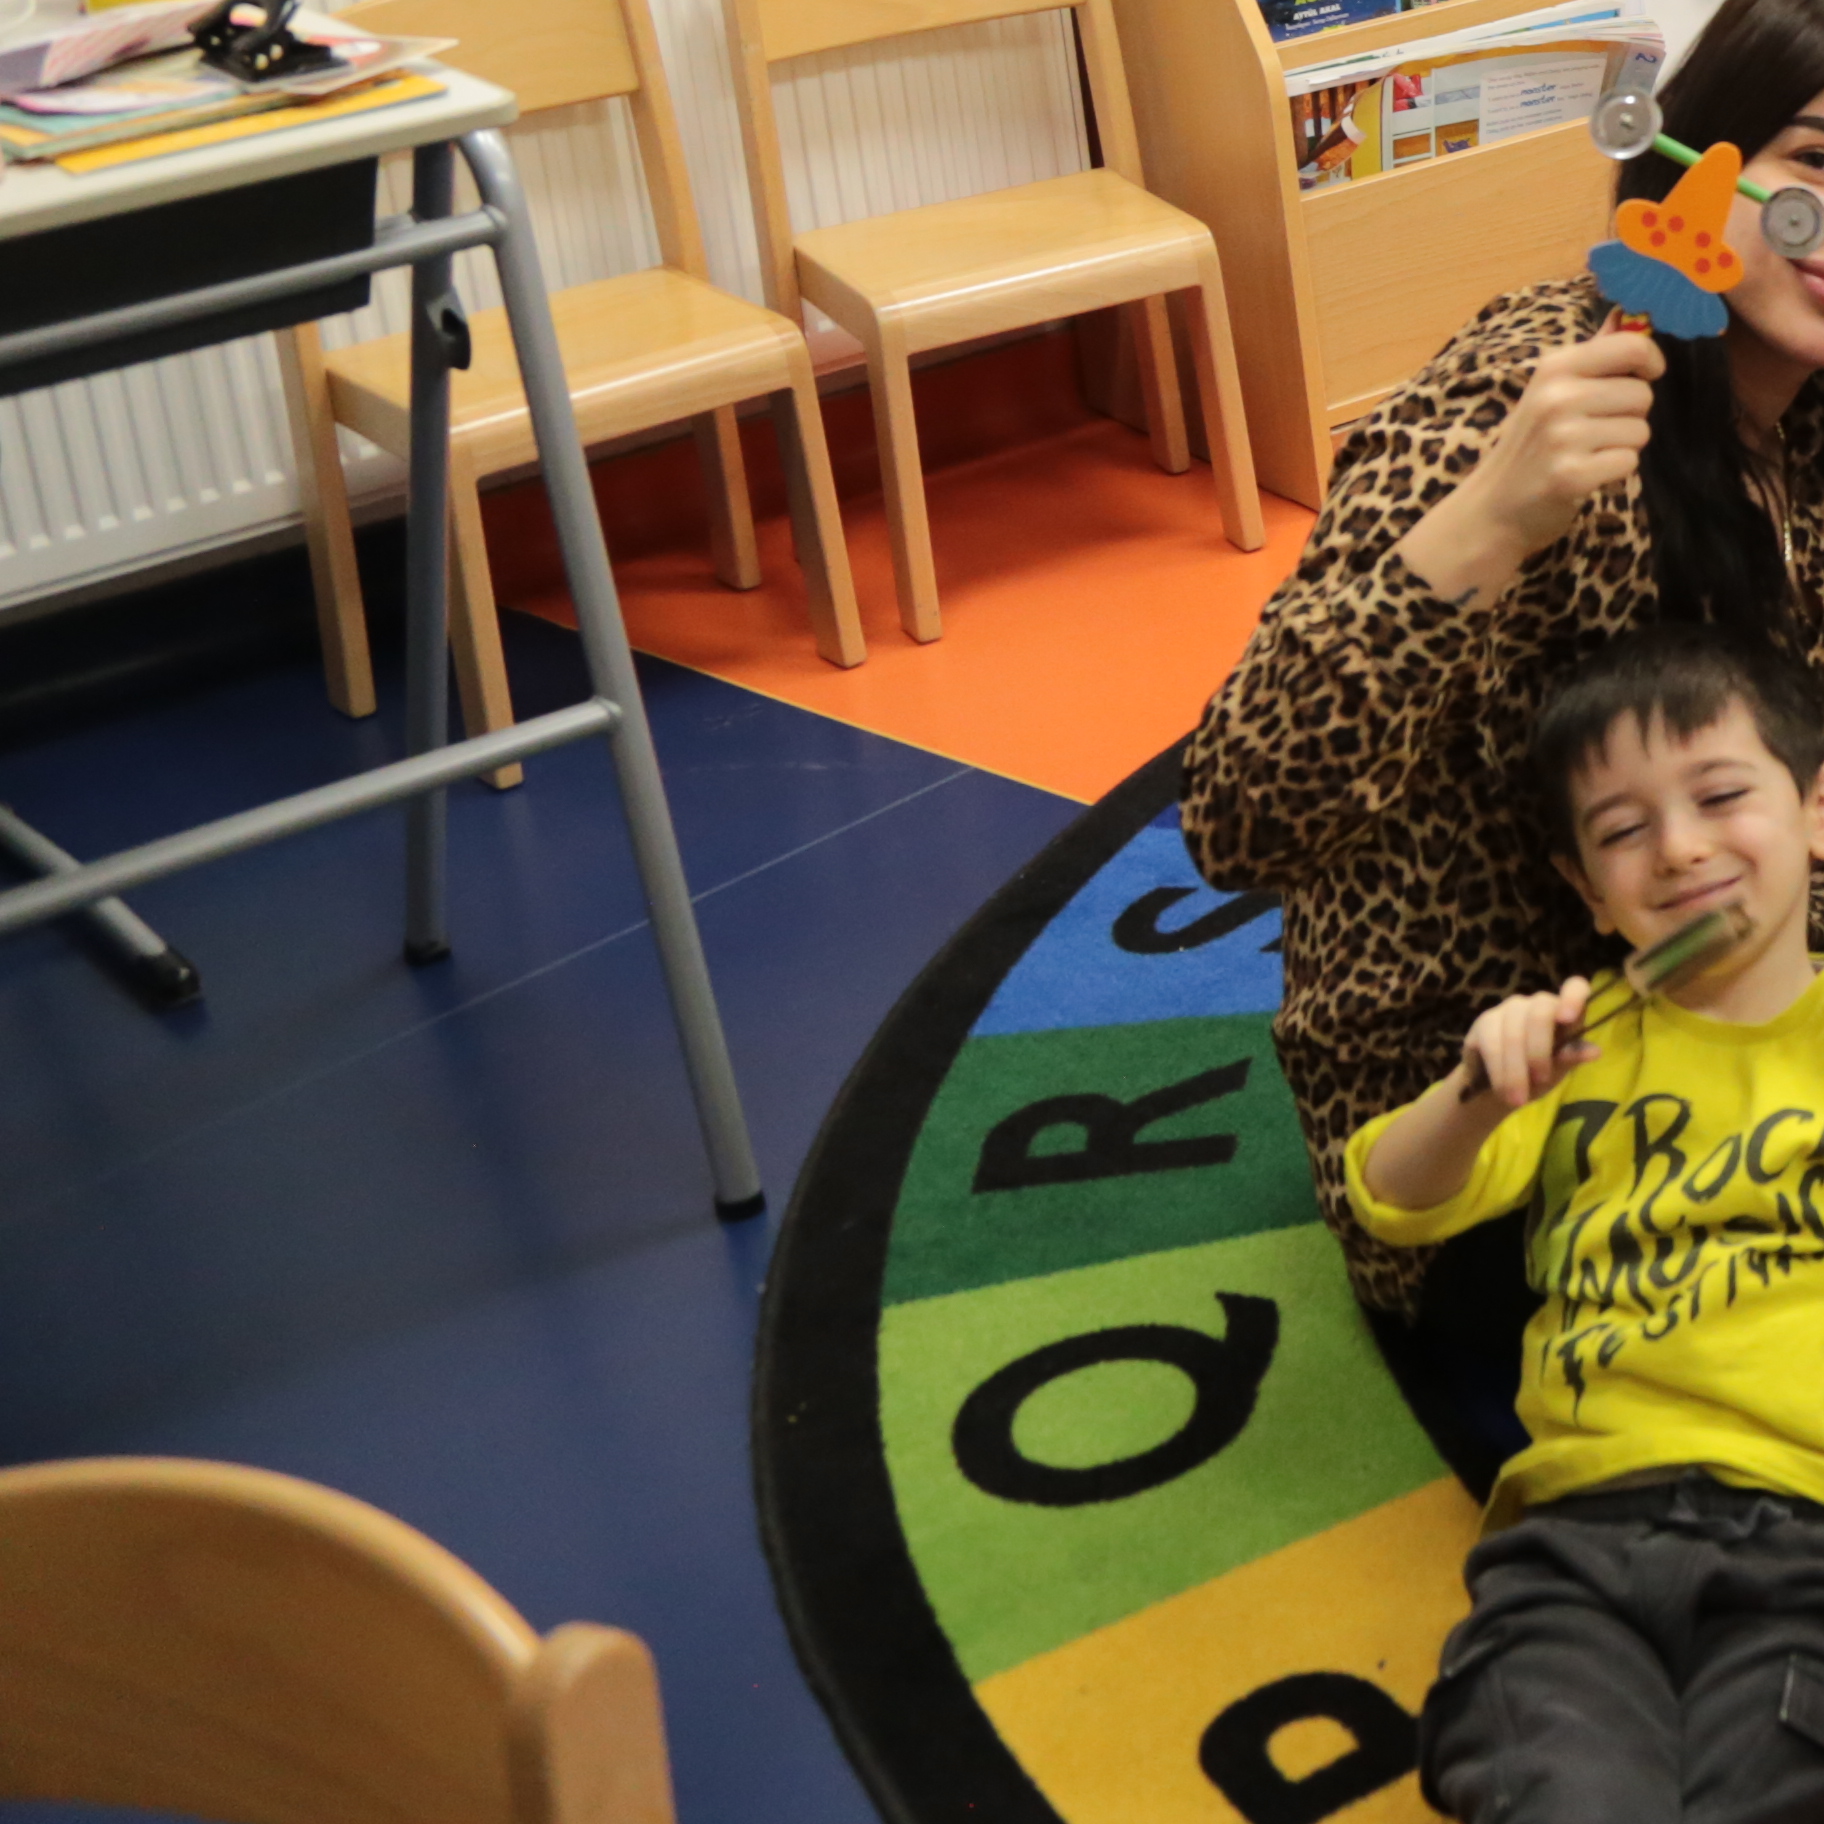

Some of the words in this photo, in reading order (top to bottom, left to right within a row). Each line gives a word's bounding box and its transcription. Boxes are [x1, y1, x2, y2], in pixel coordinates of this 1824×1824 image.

[1520, 95, 1556, 107] monster
[1521, 83, 1556, 96] monster
[971, 1057, 1252, 1195] R
[952, 1290, 1279, 1507] Q
